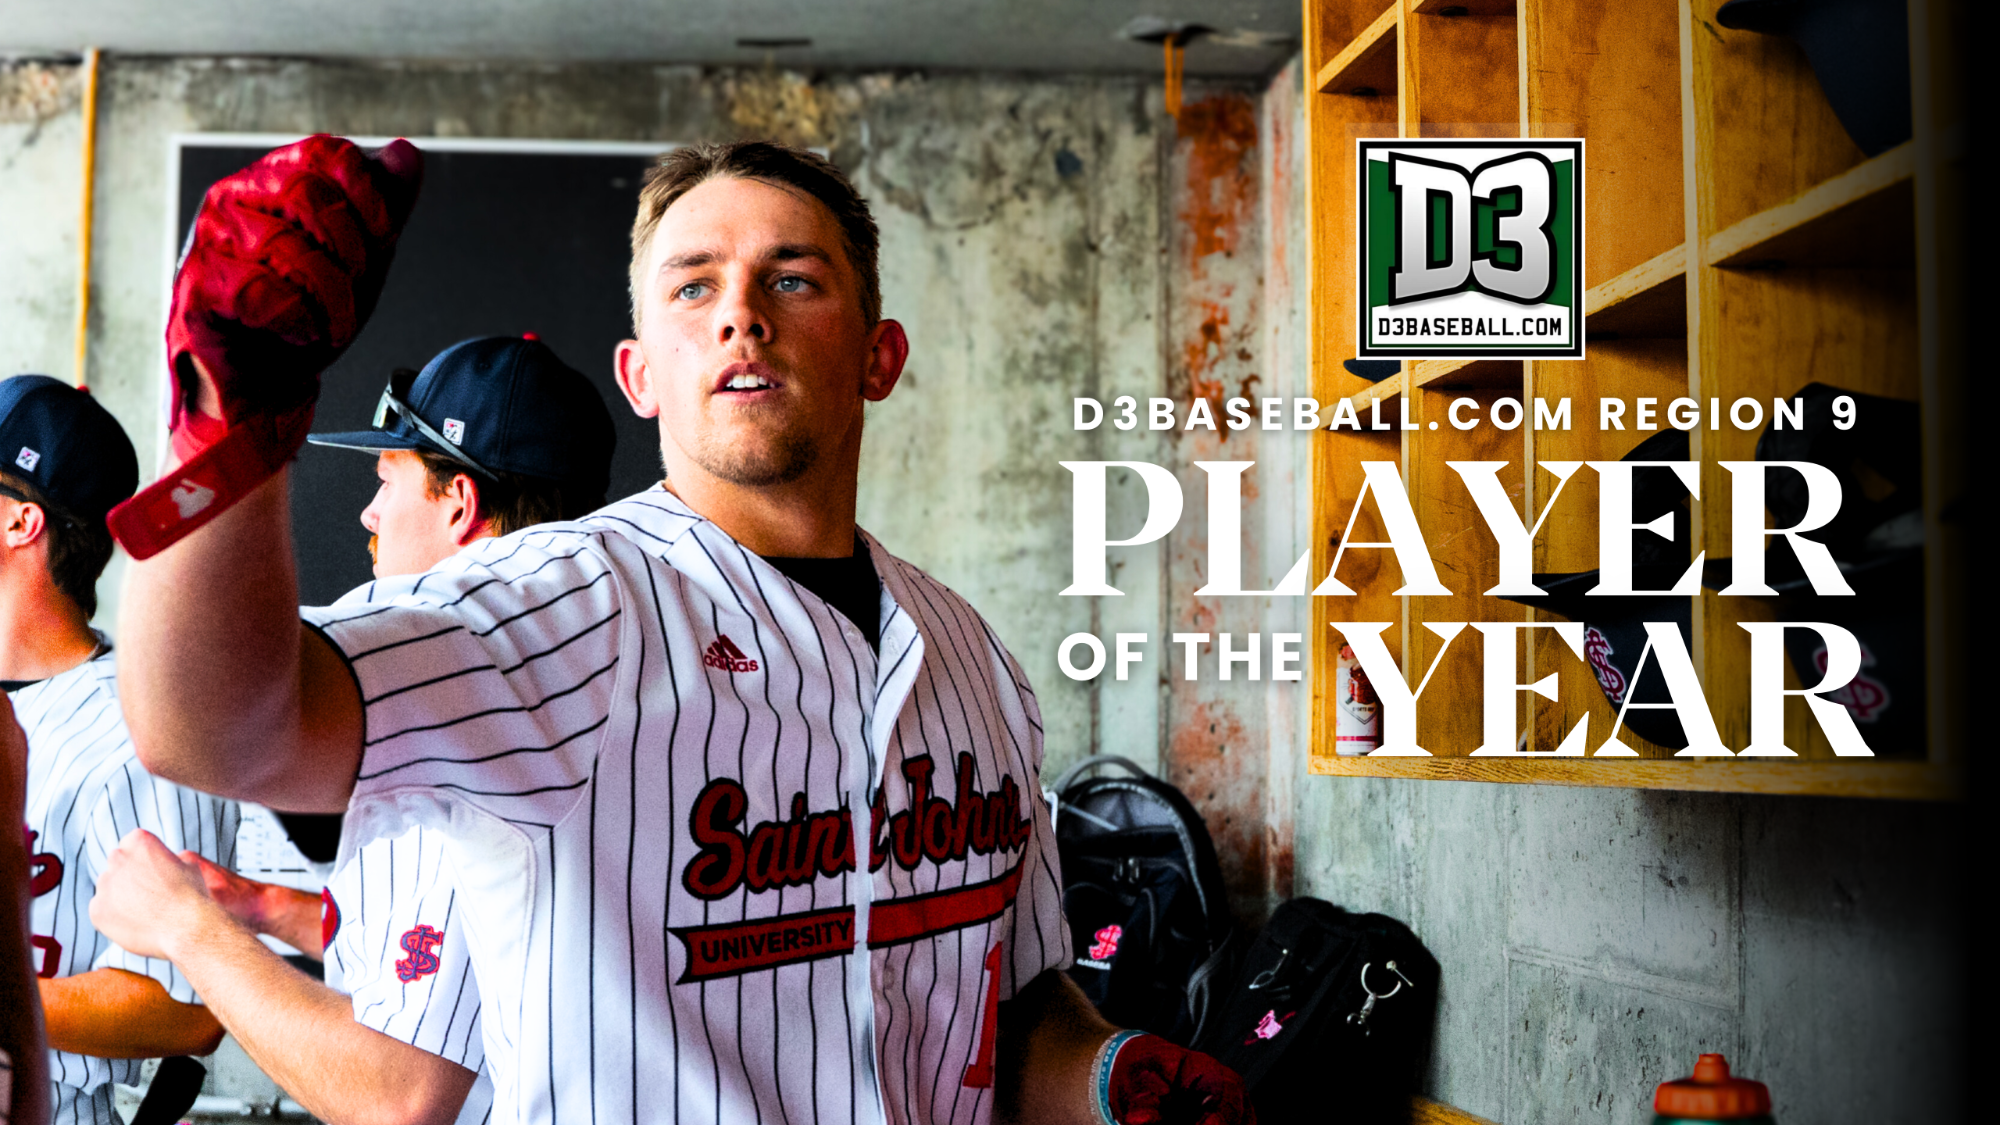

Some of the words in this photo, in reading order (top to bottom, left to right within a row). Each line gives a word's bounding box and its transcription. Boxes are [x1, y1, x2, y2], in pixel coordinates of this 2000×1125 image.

[704, 654, 759, 673] adidas
[682, 776, 889, 899] Saint
[700, 919, 851, 963] UNIVERSITY
